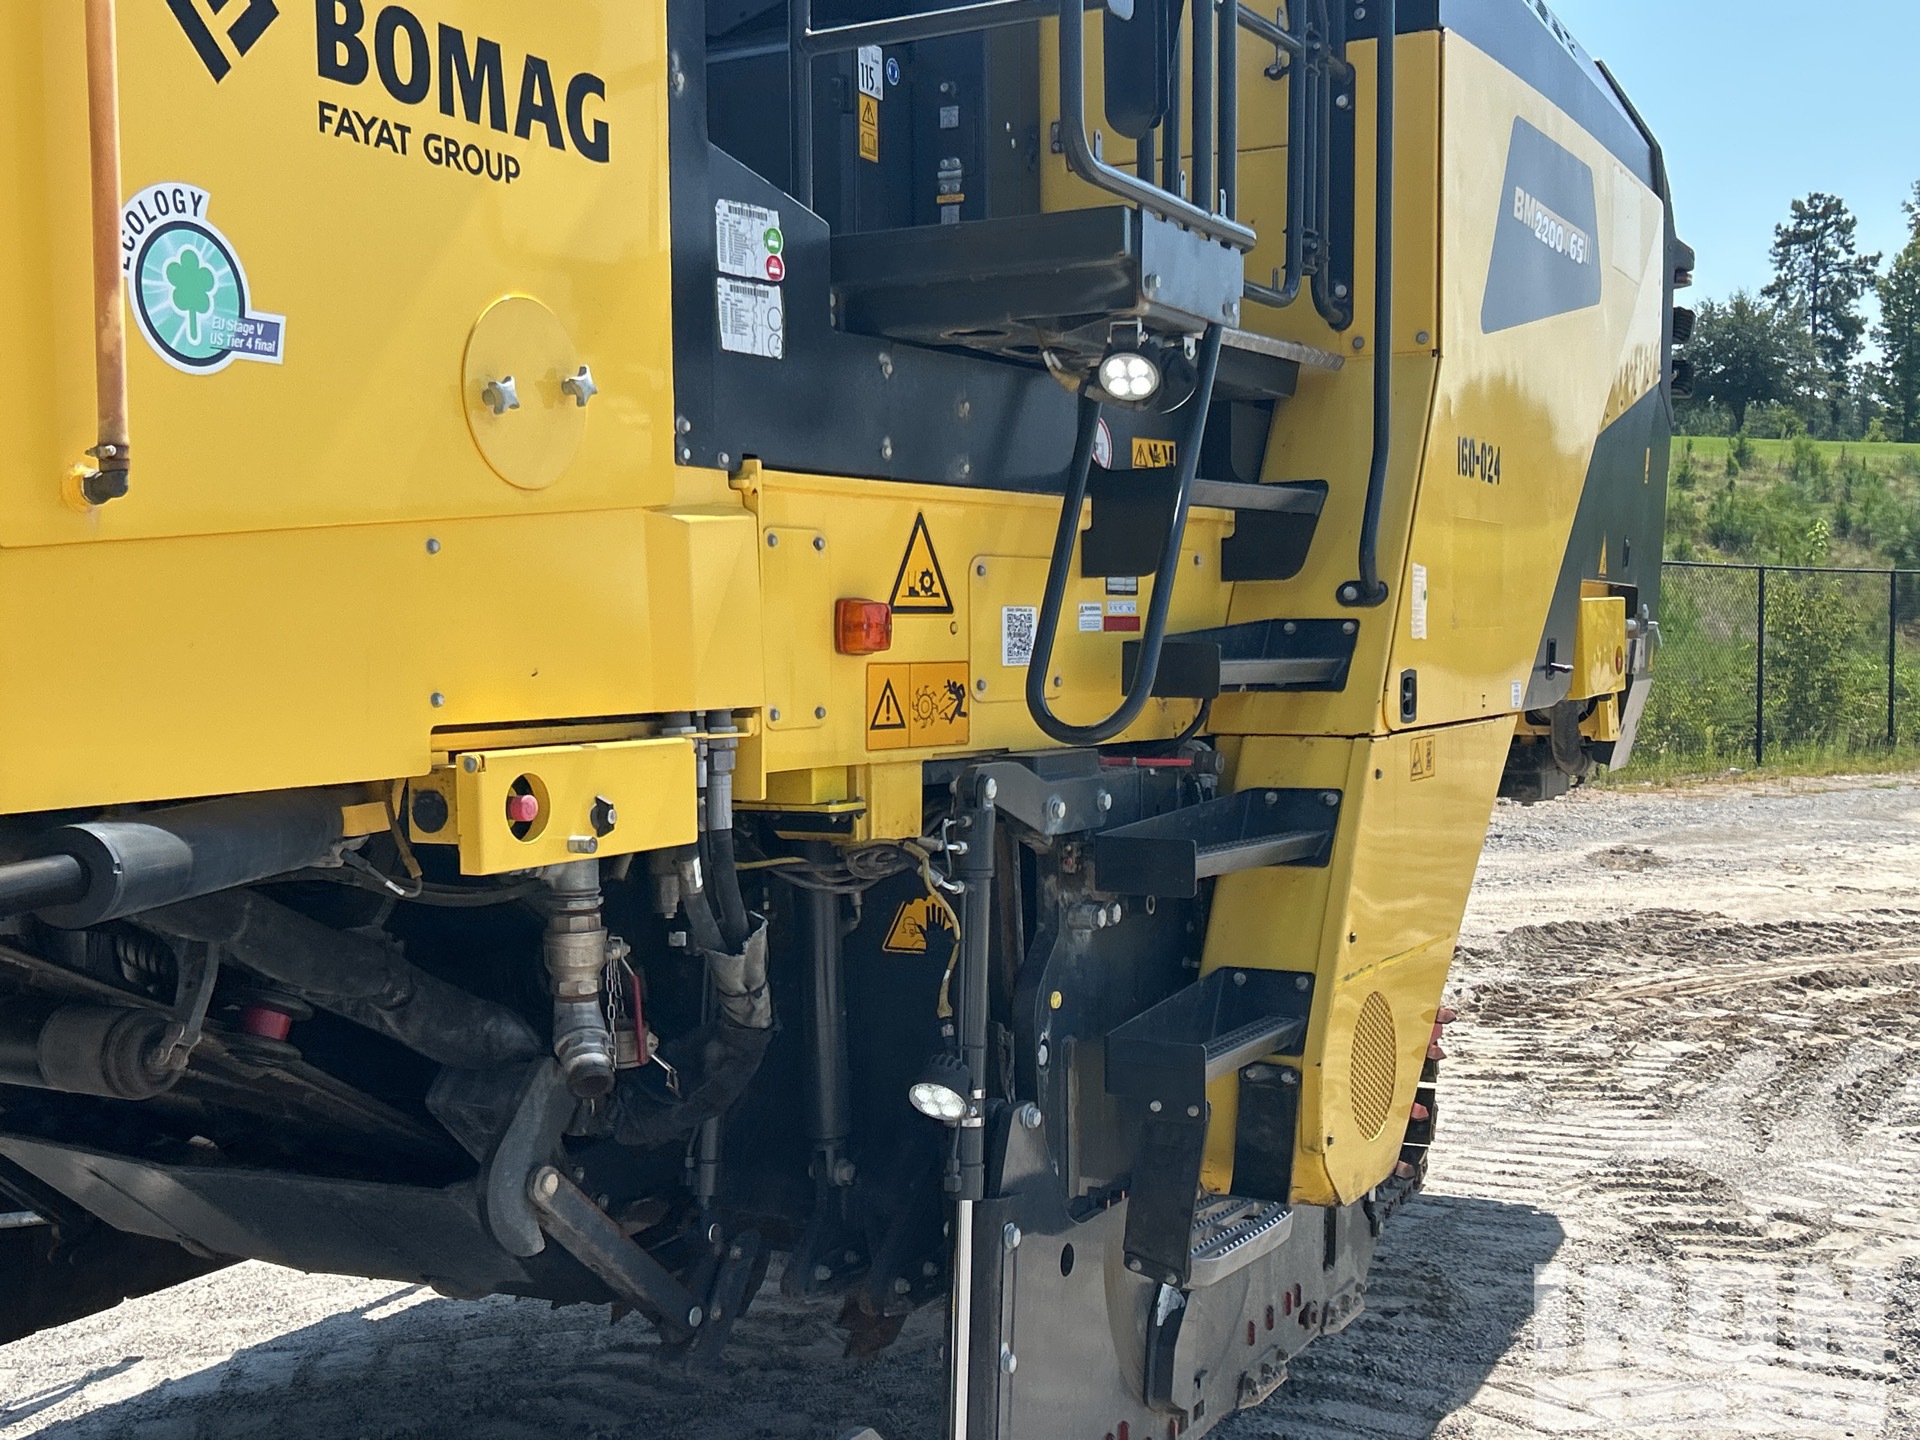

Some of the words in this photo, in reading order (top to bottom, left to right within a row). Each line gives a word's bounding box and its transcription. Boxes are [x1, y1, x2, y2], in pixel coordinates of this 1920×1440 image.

[316, 0, 611, 163] BOMAG
[860, 62, 875, 92] 115
[317, 101, 412, 157] FAYAT
[423, 133, 522, 185] GROUP
[210, 332, 224, 346] US
[226, 335, 245, 348] Tier
[246, 337, 253, 350] 4
[254, 338, 276, 353] final
[226, 319, 255, 336] Stage
[257, 322, 264, 336] V
